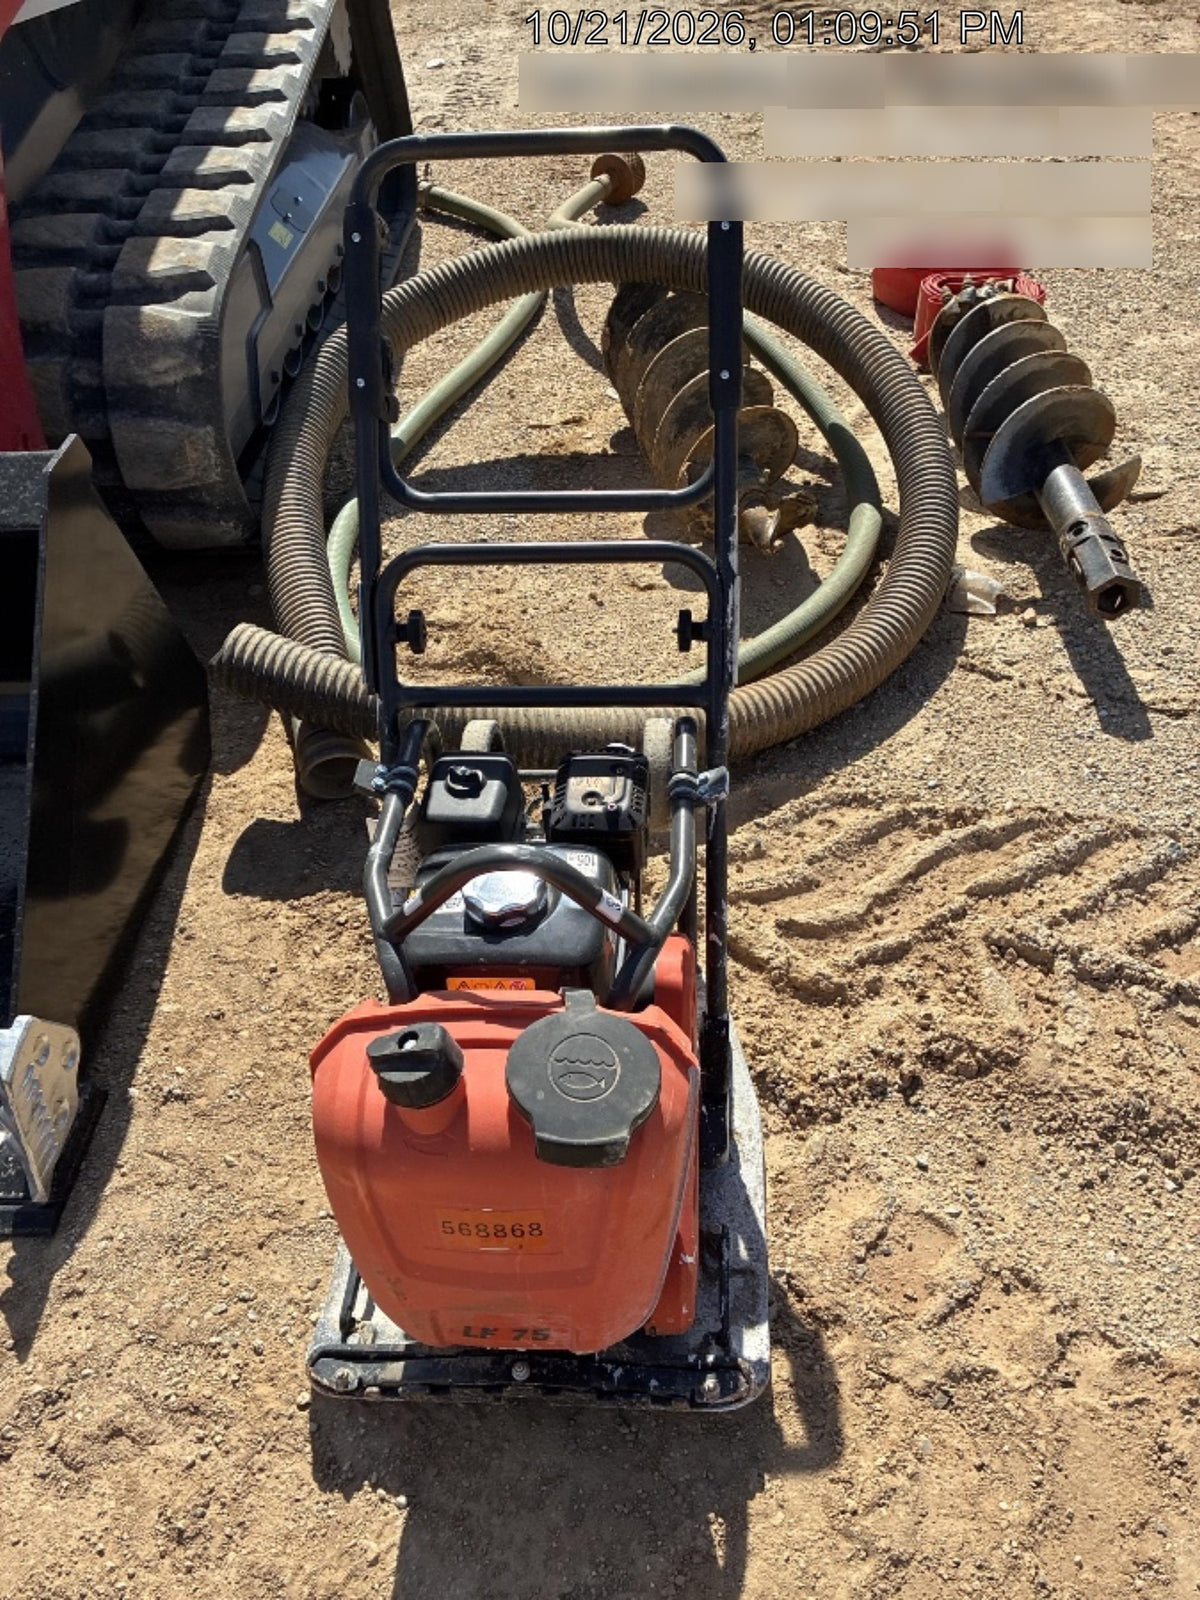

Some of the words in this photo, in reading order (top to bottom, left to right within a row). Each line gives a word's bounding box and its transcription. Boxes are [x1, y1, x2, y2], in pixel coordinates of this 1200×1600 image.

[441, 1220, 543, 1239] 568868
[461, 1325, 498, 1340] LF
[512, 1327, 551, 1342] 75
